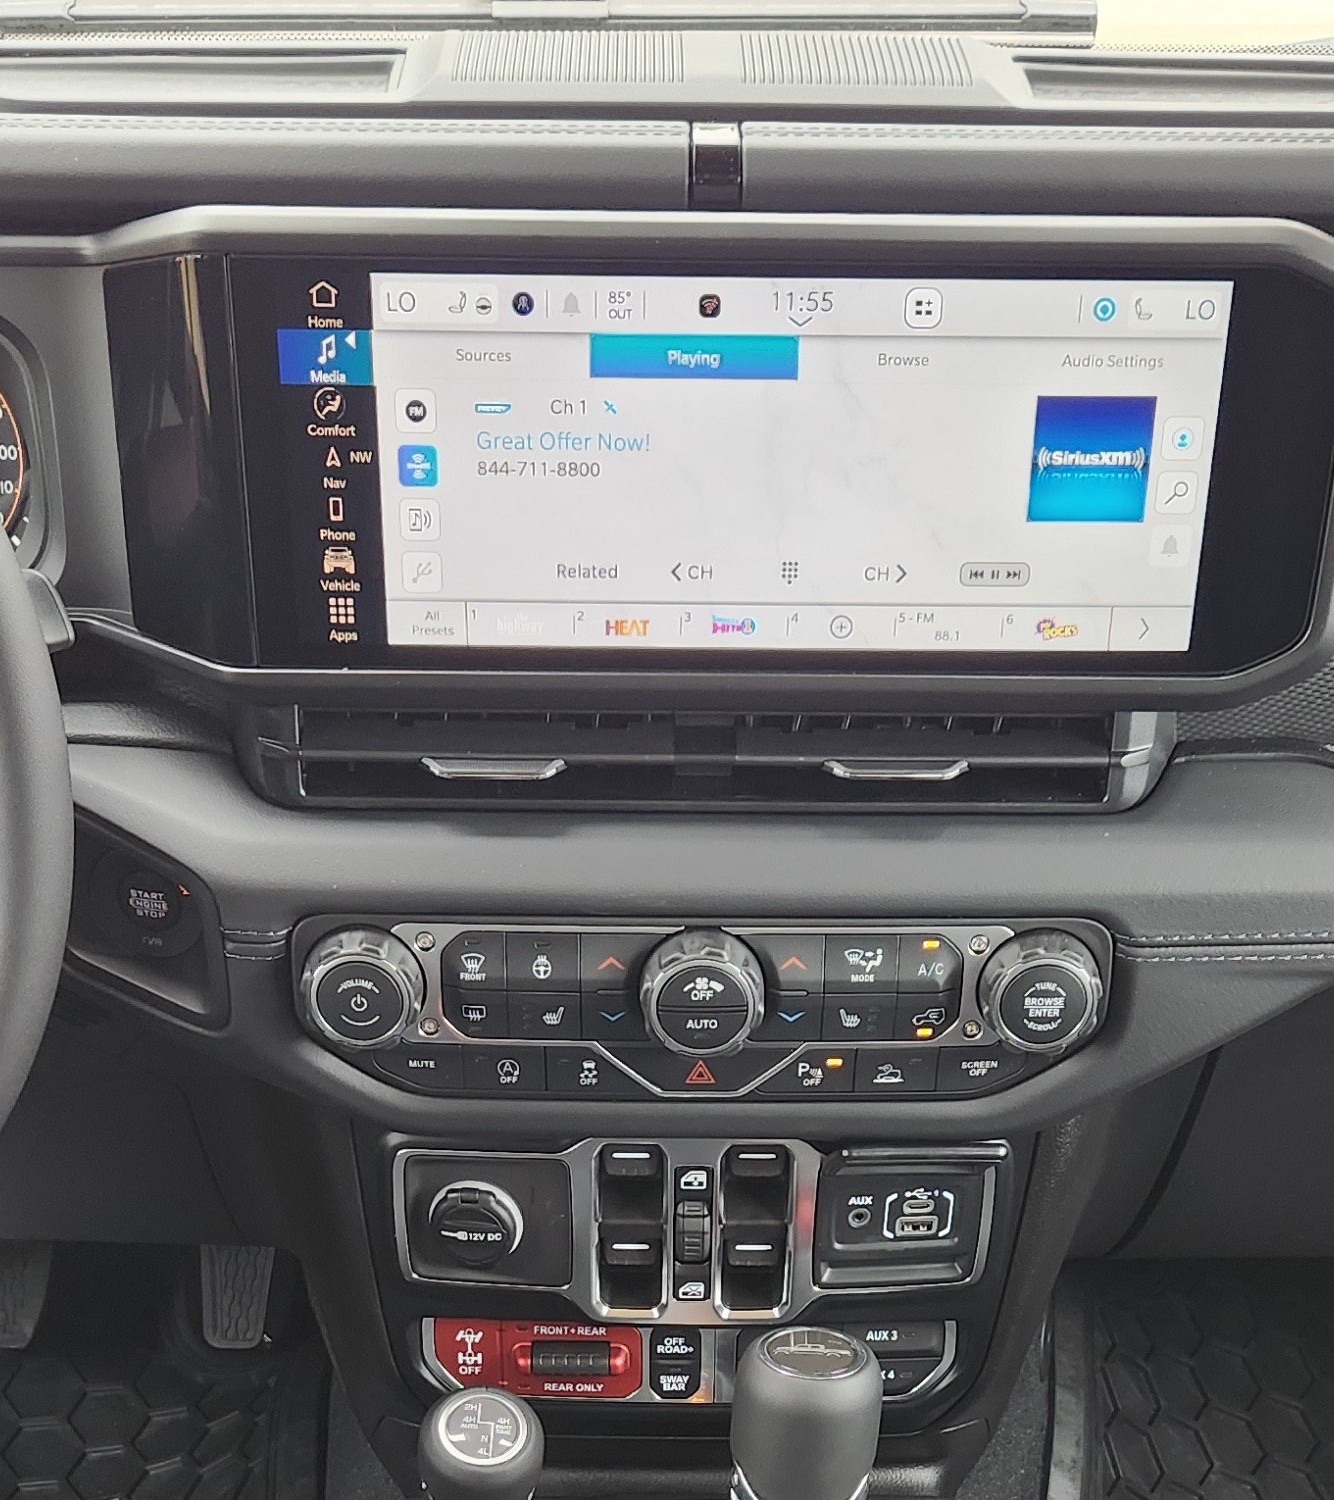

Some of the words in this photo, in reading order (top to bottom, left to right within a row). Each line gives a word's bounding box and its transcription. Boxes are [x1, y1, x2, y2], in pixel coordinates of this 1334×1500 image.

[386, 291, 416, 314] LO
[772, 291, 835, 313] 11:55
[608, 308, 633, 320] OUT
[1185, 299, 1216, 321] LO
[307, 315, 344, 329] Home
[455, 348, 512, 364] Sources
[667, 351, 721, 368] Playing
[877, 352, 930, 367] Browse
[1061, 354, 1105, 369] Audio
[1107, 354, 1165, 370] Settings
[310, 369, 347, 384] Media
[408, 405, 425, 418] FM
[549, 399, 575, 415] Ch
[580, 399, 588, 415] 1
[306, 423, 356, 437] Comfort
[476, 431, 535, 452] Great
[539, 431, 592, 452] Offer
[597, 433, 651, 453] Now!
[349, 450, 373, 463] NW
[476, 461, 602, 478] 844-711-8800
[323, 476, 347, 490] Nav
[319, 528, 356, 541] Phone
[555, 564, 619, 580] Related
[687, 565, 714, 581] CH
[864, 566, 890, 583] CH
[320, 579, 361, 592] Vehicle
[425, 610, 440, 622] All
[471, 609, 478, 620] 1
[577, 611, 585, 621] 2
[684, 612, 692, 622] 3
[791, 613, 799, 623] 4
[899, 613, 906, 623] 5
[917, 613, 935, 624] FM
[1007, 613, 1014, 624] 6
[411, 624, 455, 638] Presets
[605, 619, 650, 636] HEAT
[328, 629, 359, 644] Apps
[935, 630, 961, 641] 88.1
[130, 889, 164, 900] START
[917, 962, 944, 977] A/C
[460, 972, 486, 981] FRONT
[851, 974, 875, 983] MODE
[340, 979, 374, 990] VOLUME
[1035, 982, 1057, 991] TUNE
[691, 990, 713, 1001] OFF
[1024, 997, 1065, 1006] BROWSE
[1029, 1008, 1060, 1018] ENTER
[686, 1019, 717, 1029] AUTO
[1028, 1022, 1058, 1031] SCROLL
[409, 1060, 435, 1069] MUTE
[797, 1063, 809, 1077] P
[961, 1060, 998, 1069] SCREEN
[969, 1068, 988, 1077] OFF
[500, 1075, 518, 1084] OFF
[579, 1076, 598, 1085] OFF
[803, 1077, 821, 1087] OFF
[848, 1196, 874, 1206] AUX
[468, 1231, 485, 1241] 12V
[487, 1231, 502, 1241] DC
[663, 1336, 685, 1346] OFF
[866, 1330, 888, 1341] AUX
[891, 1330, 898, 1341] 3
[458, 1365, 483, 1376] OFF
[659, 1374, 689, 1385] SWAY
[544, 1382, 572, 1392] REAR
[574, 1382, 604, 1393] ONLY
[662, 1382, 686, 1392] BAR
[464, 1403, 478, 1411] 2H
[497, 1417, 510, 1425] 4H
[481, 1435, 489, 1443] N
[477, 1447, 489, 1455] 4L
